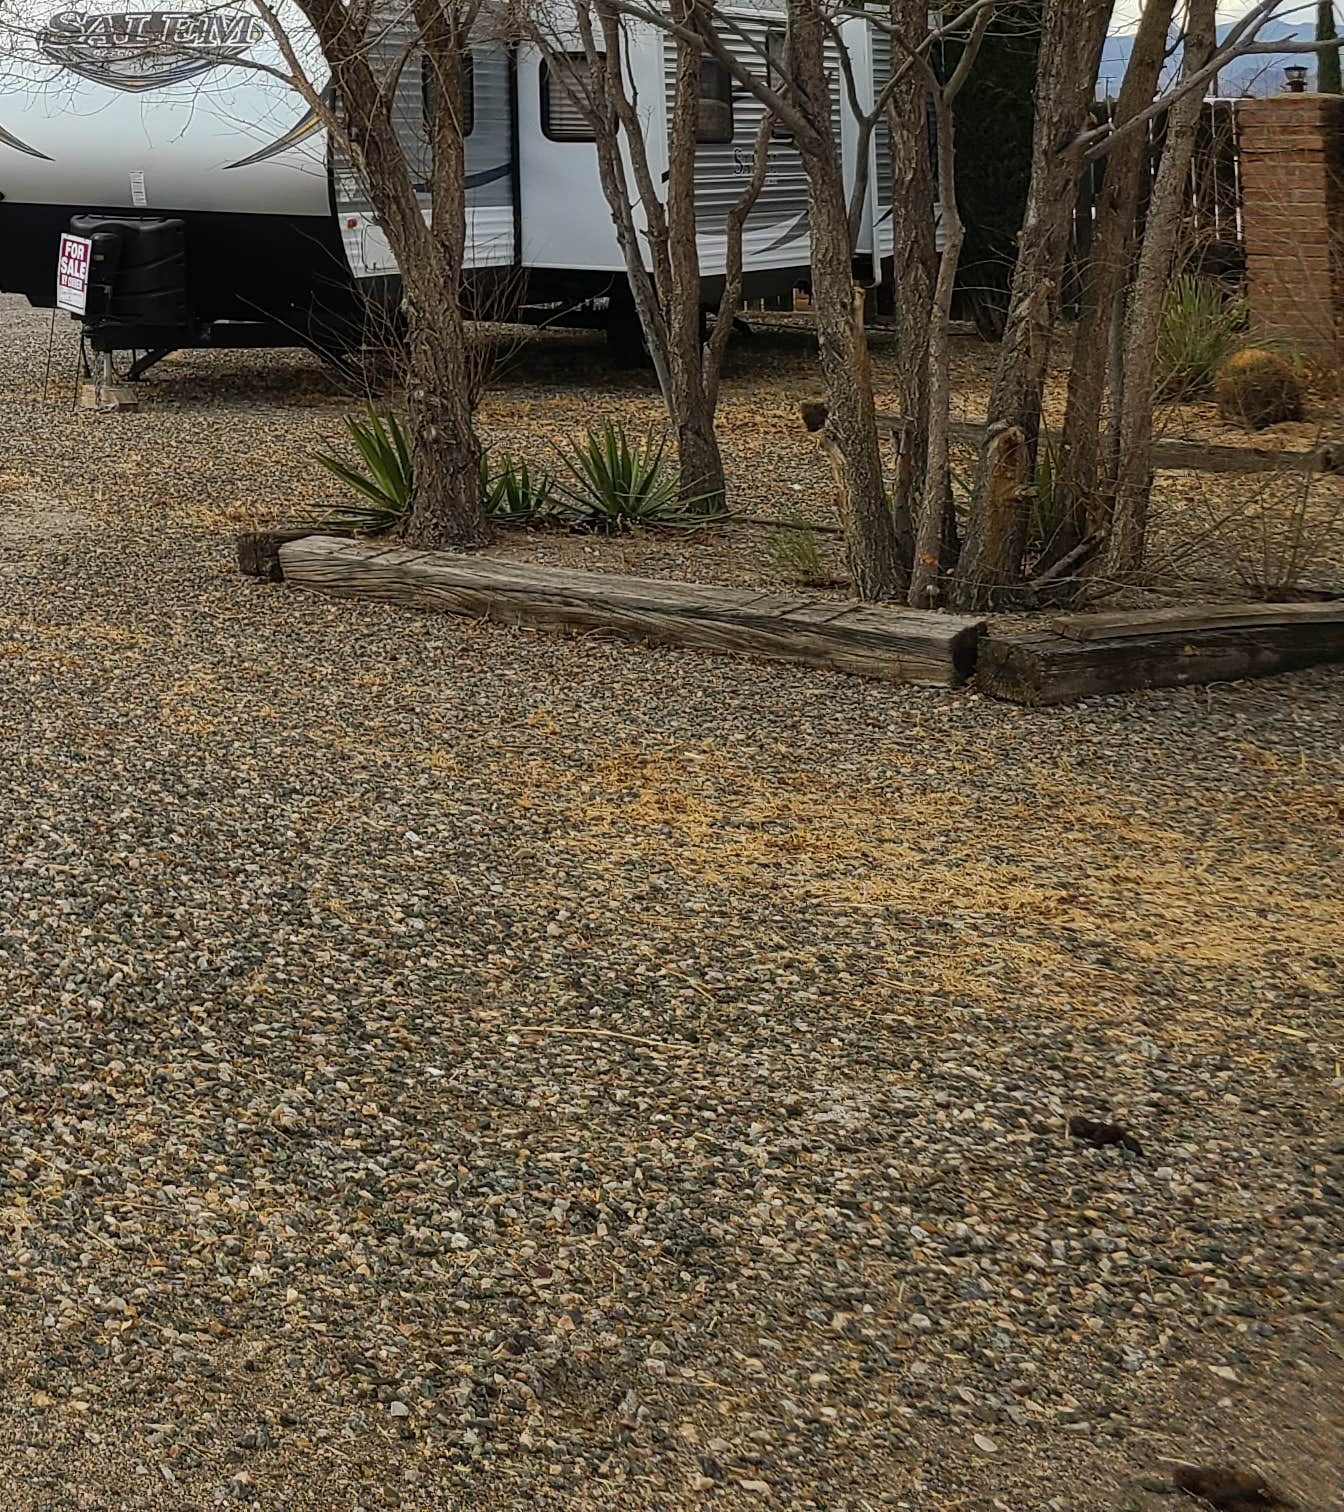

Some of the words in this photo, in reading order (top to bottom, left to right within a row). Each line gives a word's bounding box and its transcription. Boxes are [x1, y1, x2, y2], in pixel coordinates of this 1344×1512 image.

[49, 11, 258, 46] SALEM
[64, 241, 85, 261] FOR
[60, 257, 87, 280] SALE
